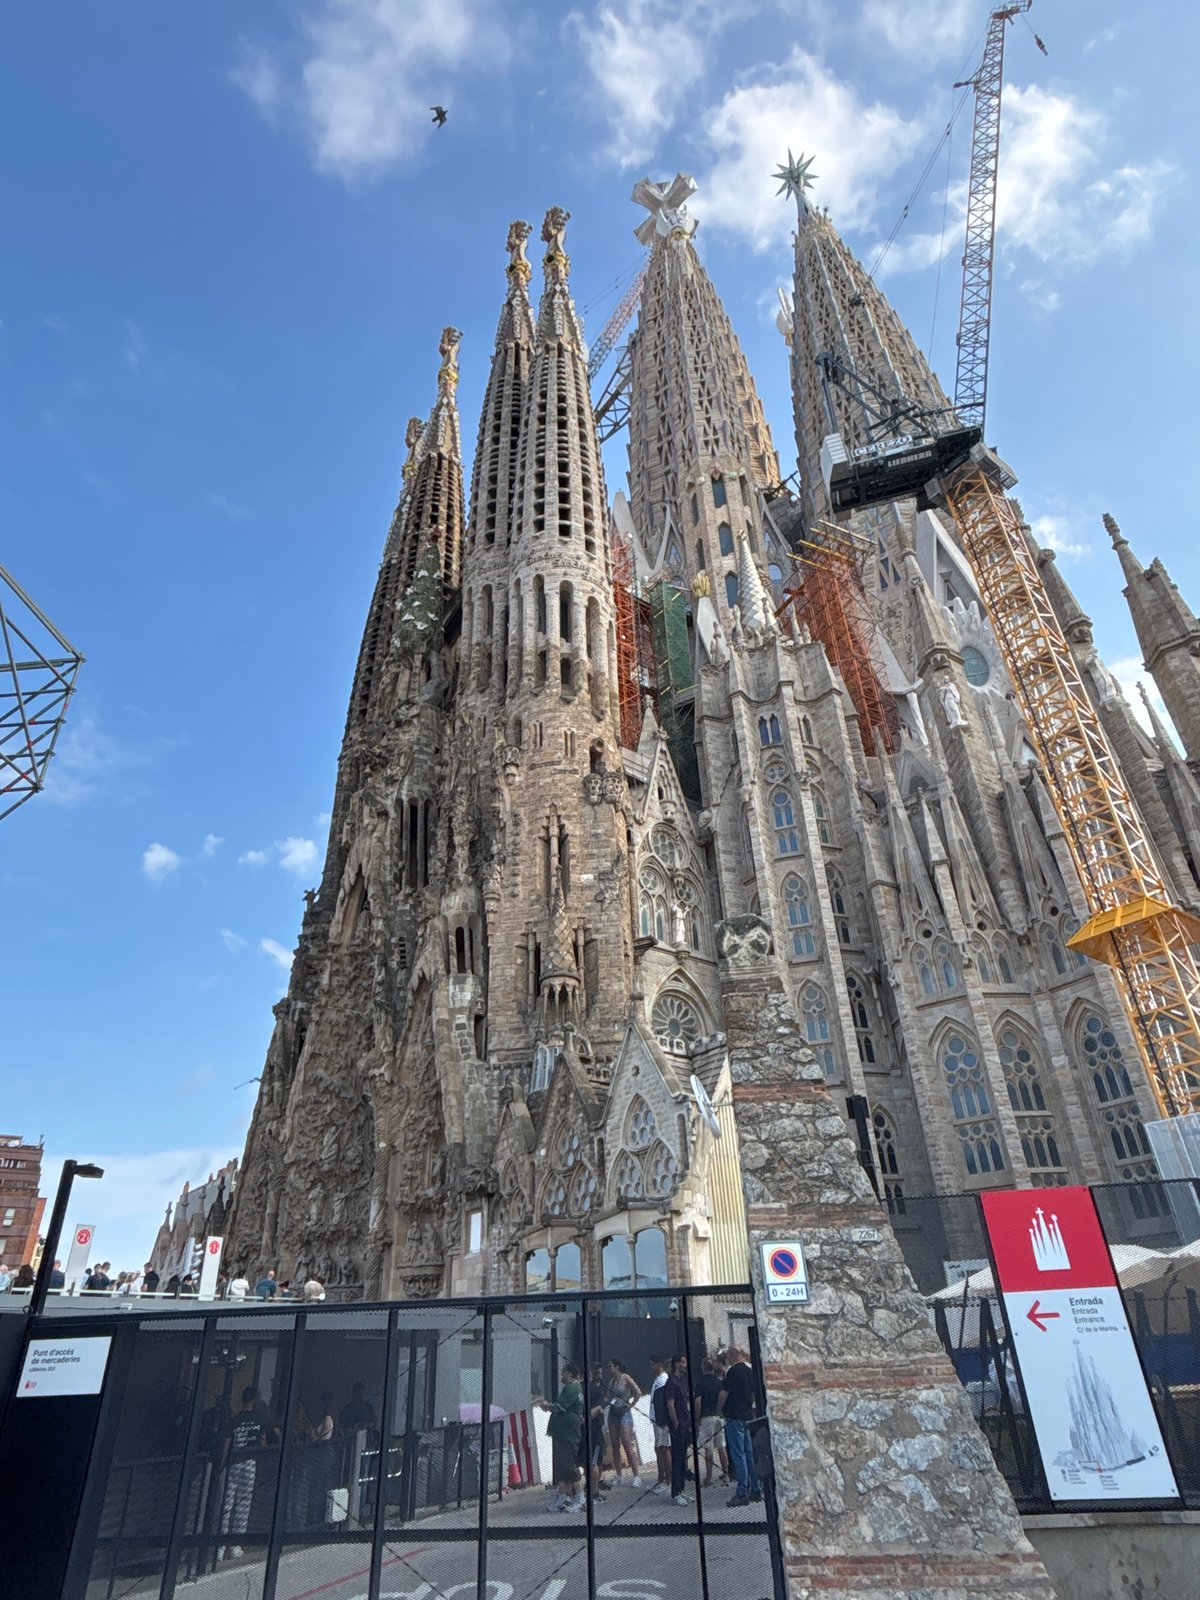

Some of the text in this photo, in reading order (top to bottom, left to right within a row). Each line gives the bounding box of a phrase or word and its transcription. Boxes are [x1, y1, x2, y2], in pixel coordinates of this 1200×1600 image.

[856, 436, 909, 455] CEREZO
[887, 450, 932, 467] LIEBHERR
[80, 1232, 87, 1242] 2
[858, 1229, 876, 1240] 2267
[772, 1289, 778, 1297] 0
[786, 1288, 804, 1297] 24H
[1069, 1297, 1104, 1306] Entrada
[1071, 1307, 1099, 1315] Entrada
[1074, 1316, 1105, 1324] Entrance
[33, 1349, 48, 1357] Punt
[41, 1356, 81, 1364] mercaderies
